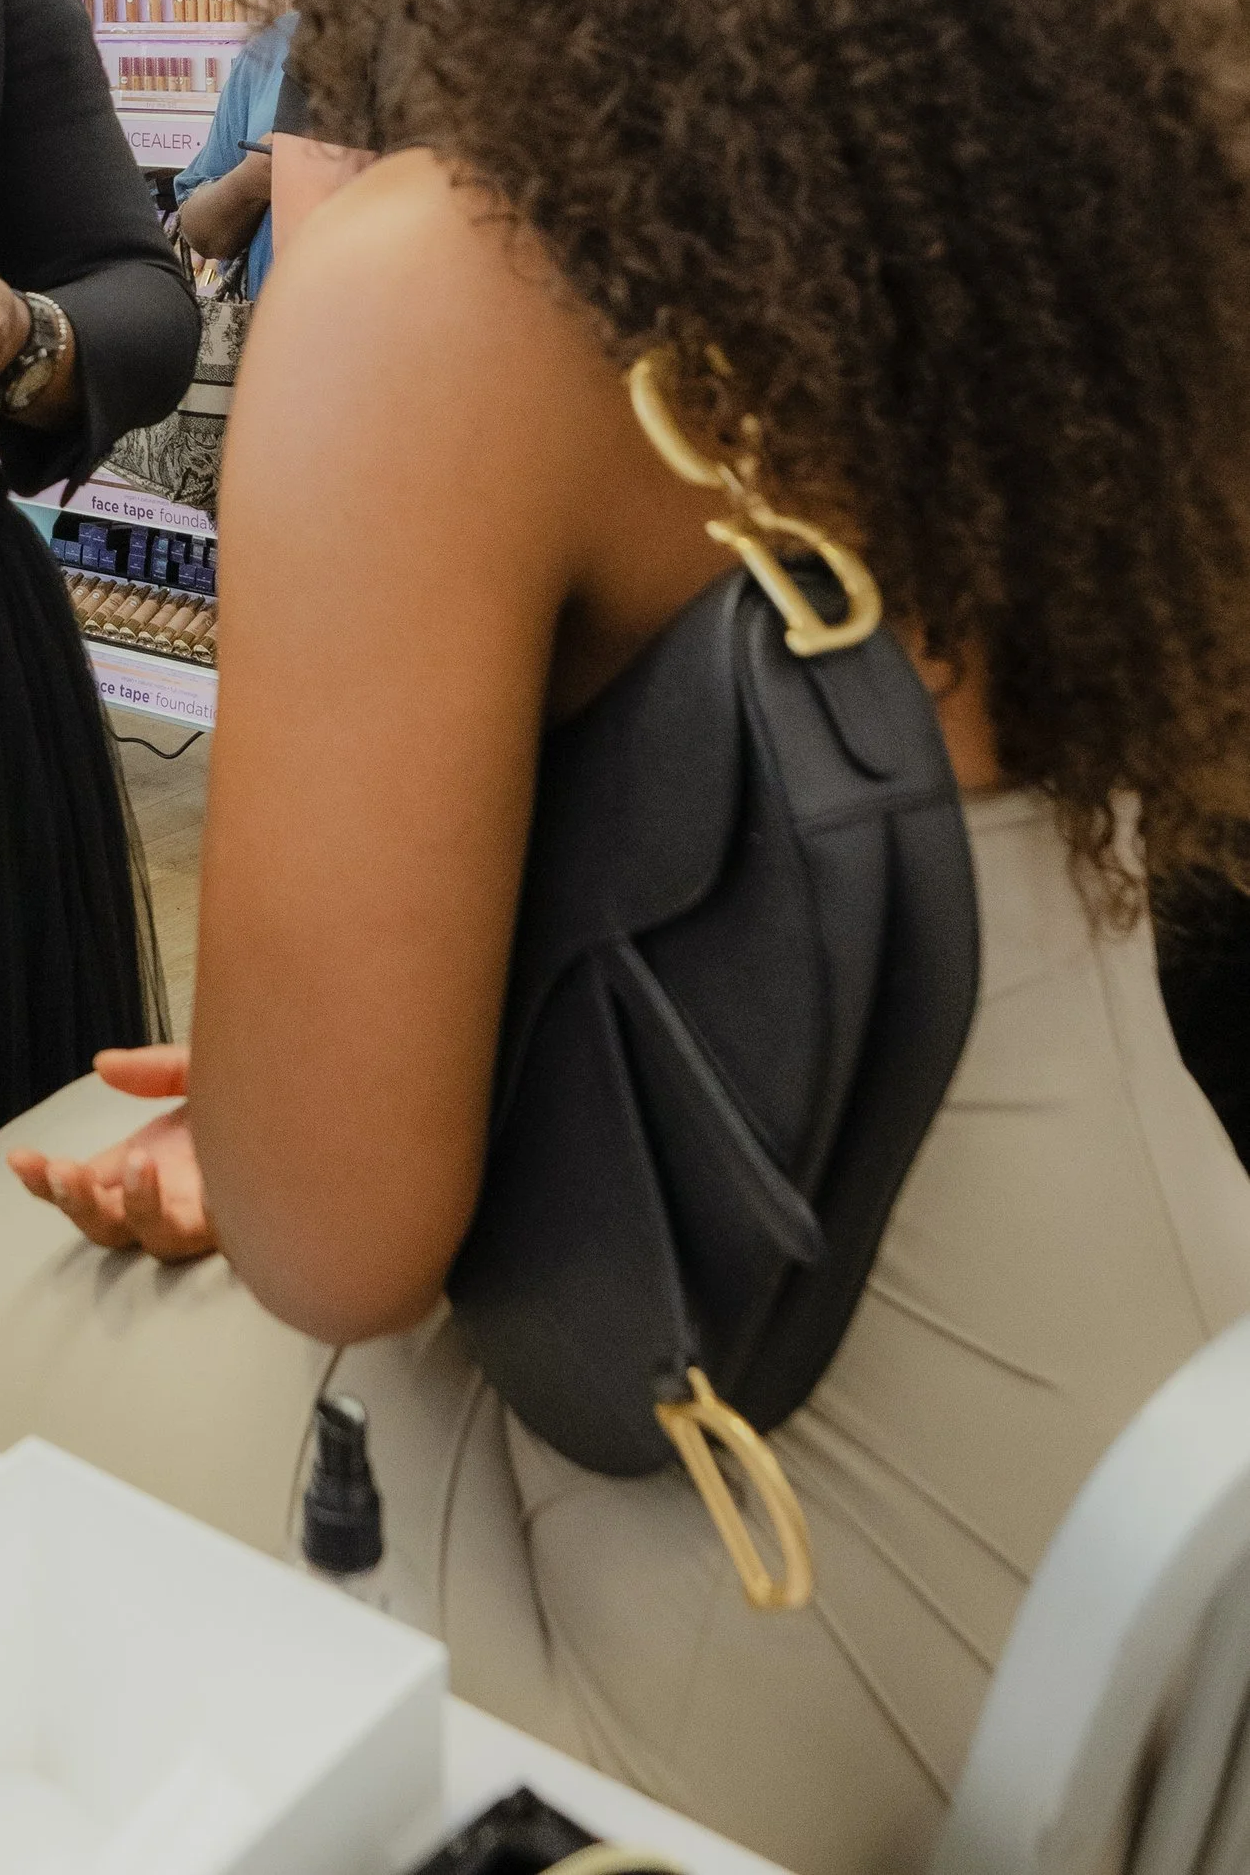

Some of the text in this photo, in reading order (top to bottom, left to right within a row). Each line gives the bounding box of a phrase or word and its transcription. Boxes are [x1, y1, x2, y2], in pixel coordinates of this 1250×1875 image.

[91, 495, 120, 513] face
[123, 501, 154, 520] tape
[119, 684, 150, 703] tape
